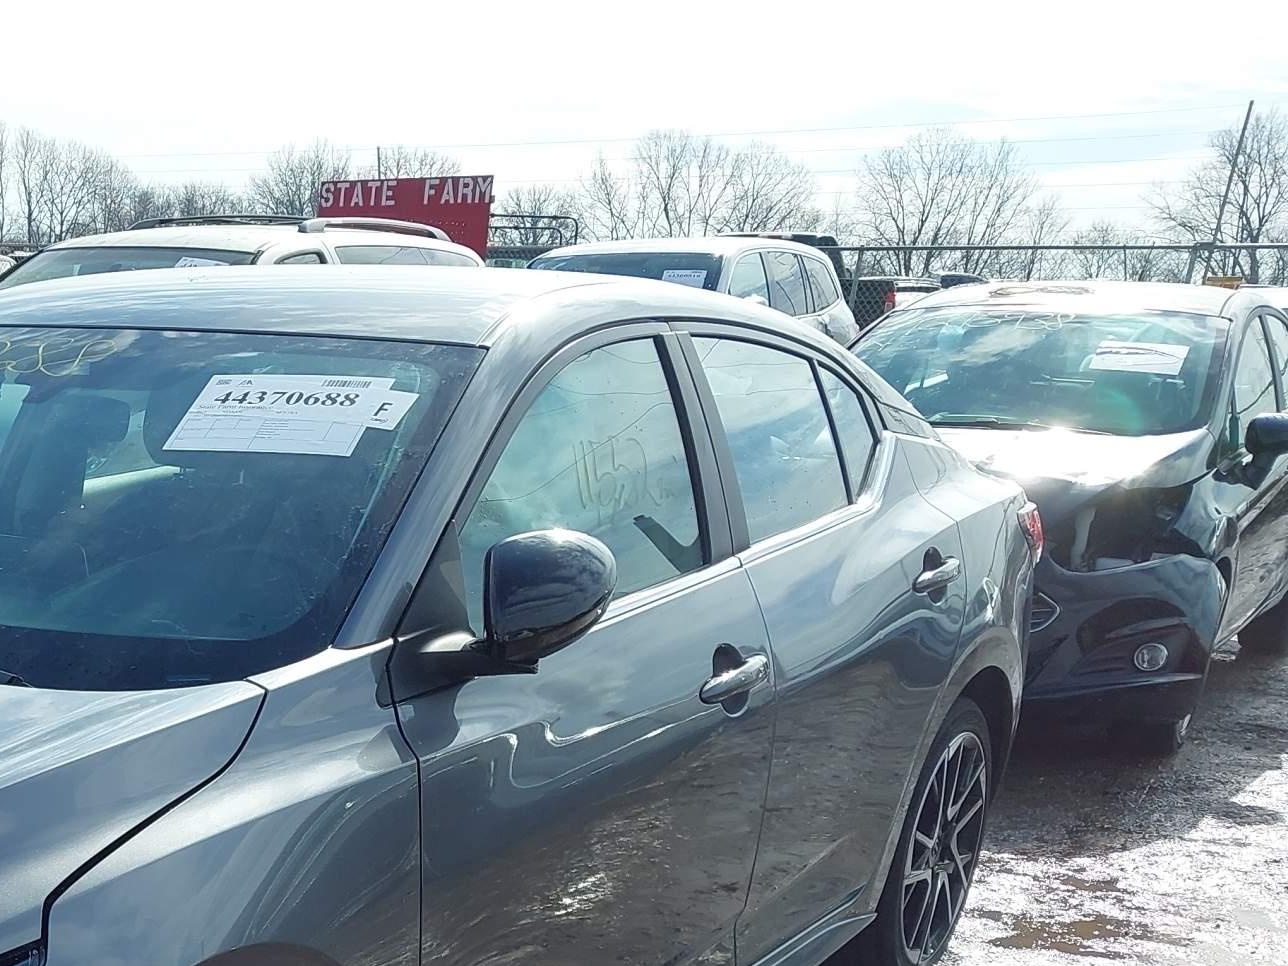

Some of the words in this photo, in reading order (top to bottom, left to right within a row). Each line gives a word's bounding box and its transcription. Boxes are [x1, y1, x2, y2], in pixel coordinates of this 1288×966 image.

[320, 180, 398, 208] STATE
[423, 176, 495, 205] FARM
[214, 390, 361, 407] 44370688
[373, 402, 393, 416] F
